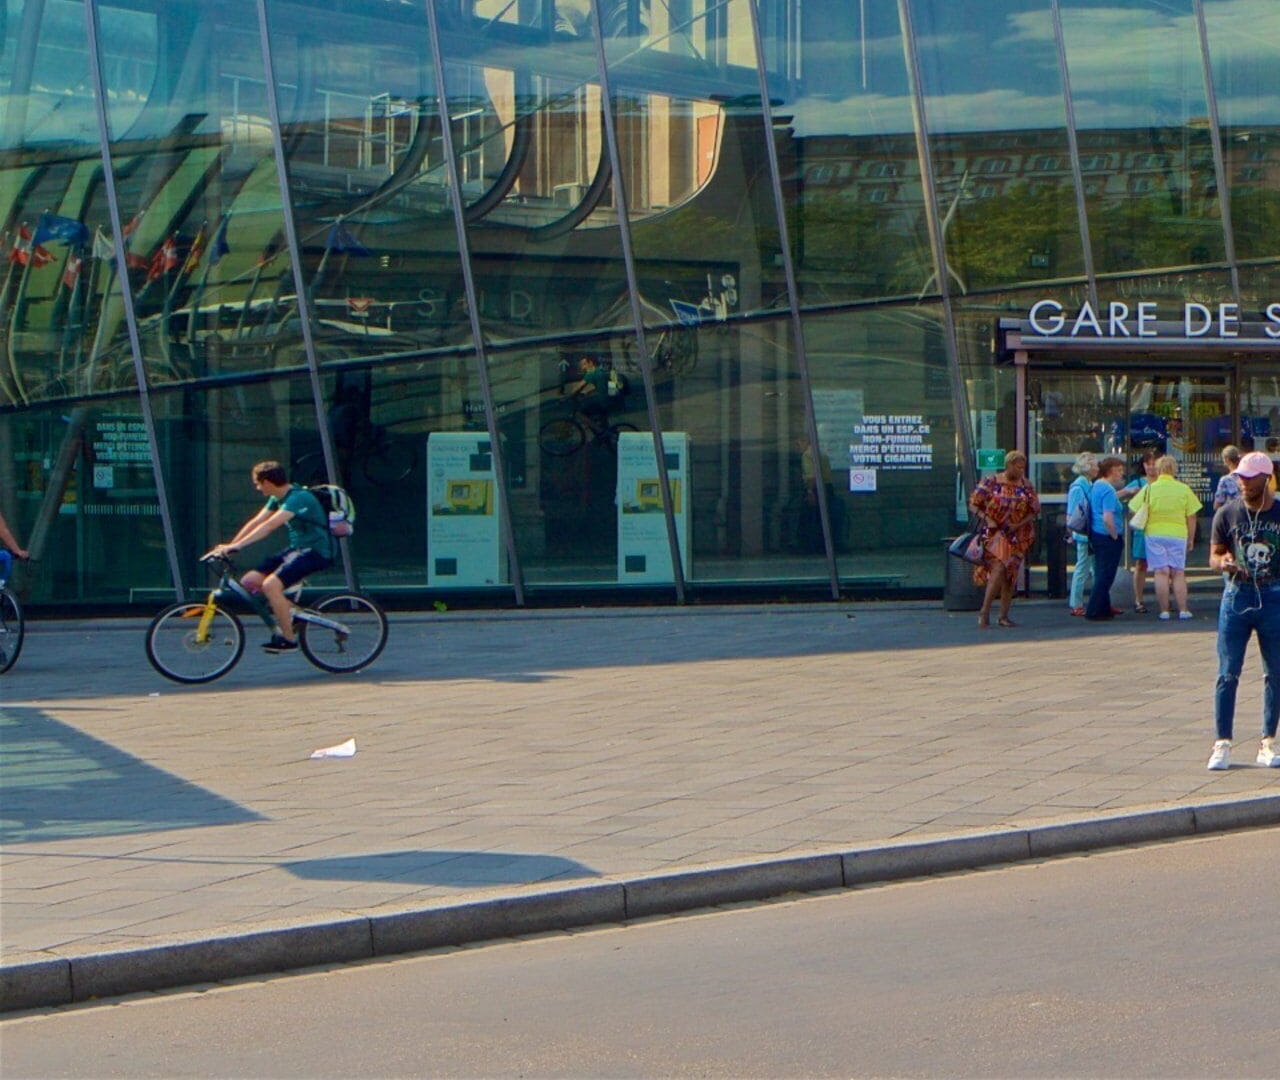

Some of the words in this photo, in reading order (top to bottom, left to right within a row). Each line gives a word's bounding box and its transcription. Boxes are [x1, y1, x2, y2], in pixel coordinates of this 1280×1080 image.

[1029, 299, 1158, 337] GARE
[1184, 302, 1239, 338] DE
[862, 416, 886, 424] VOUS
[888, 416, 923, 424] ENTREZ
[854, 425, 880, 434] DANS
[881, 425, 895, 434] UN
[897, 425, 931, 434] ESPCE
[862, 435, 923, 444] NON-FUMEUR
[850, 445, 879, 453] MERCI
[881, 443, 933, 453] D'ÉTEINDRE
[853, 454, 882, 463] VOTRE
[884, 454, 933, 463] CIGARETTE
